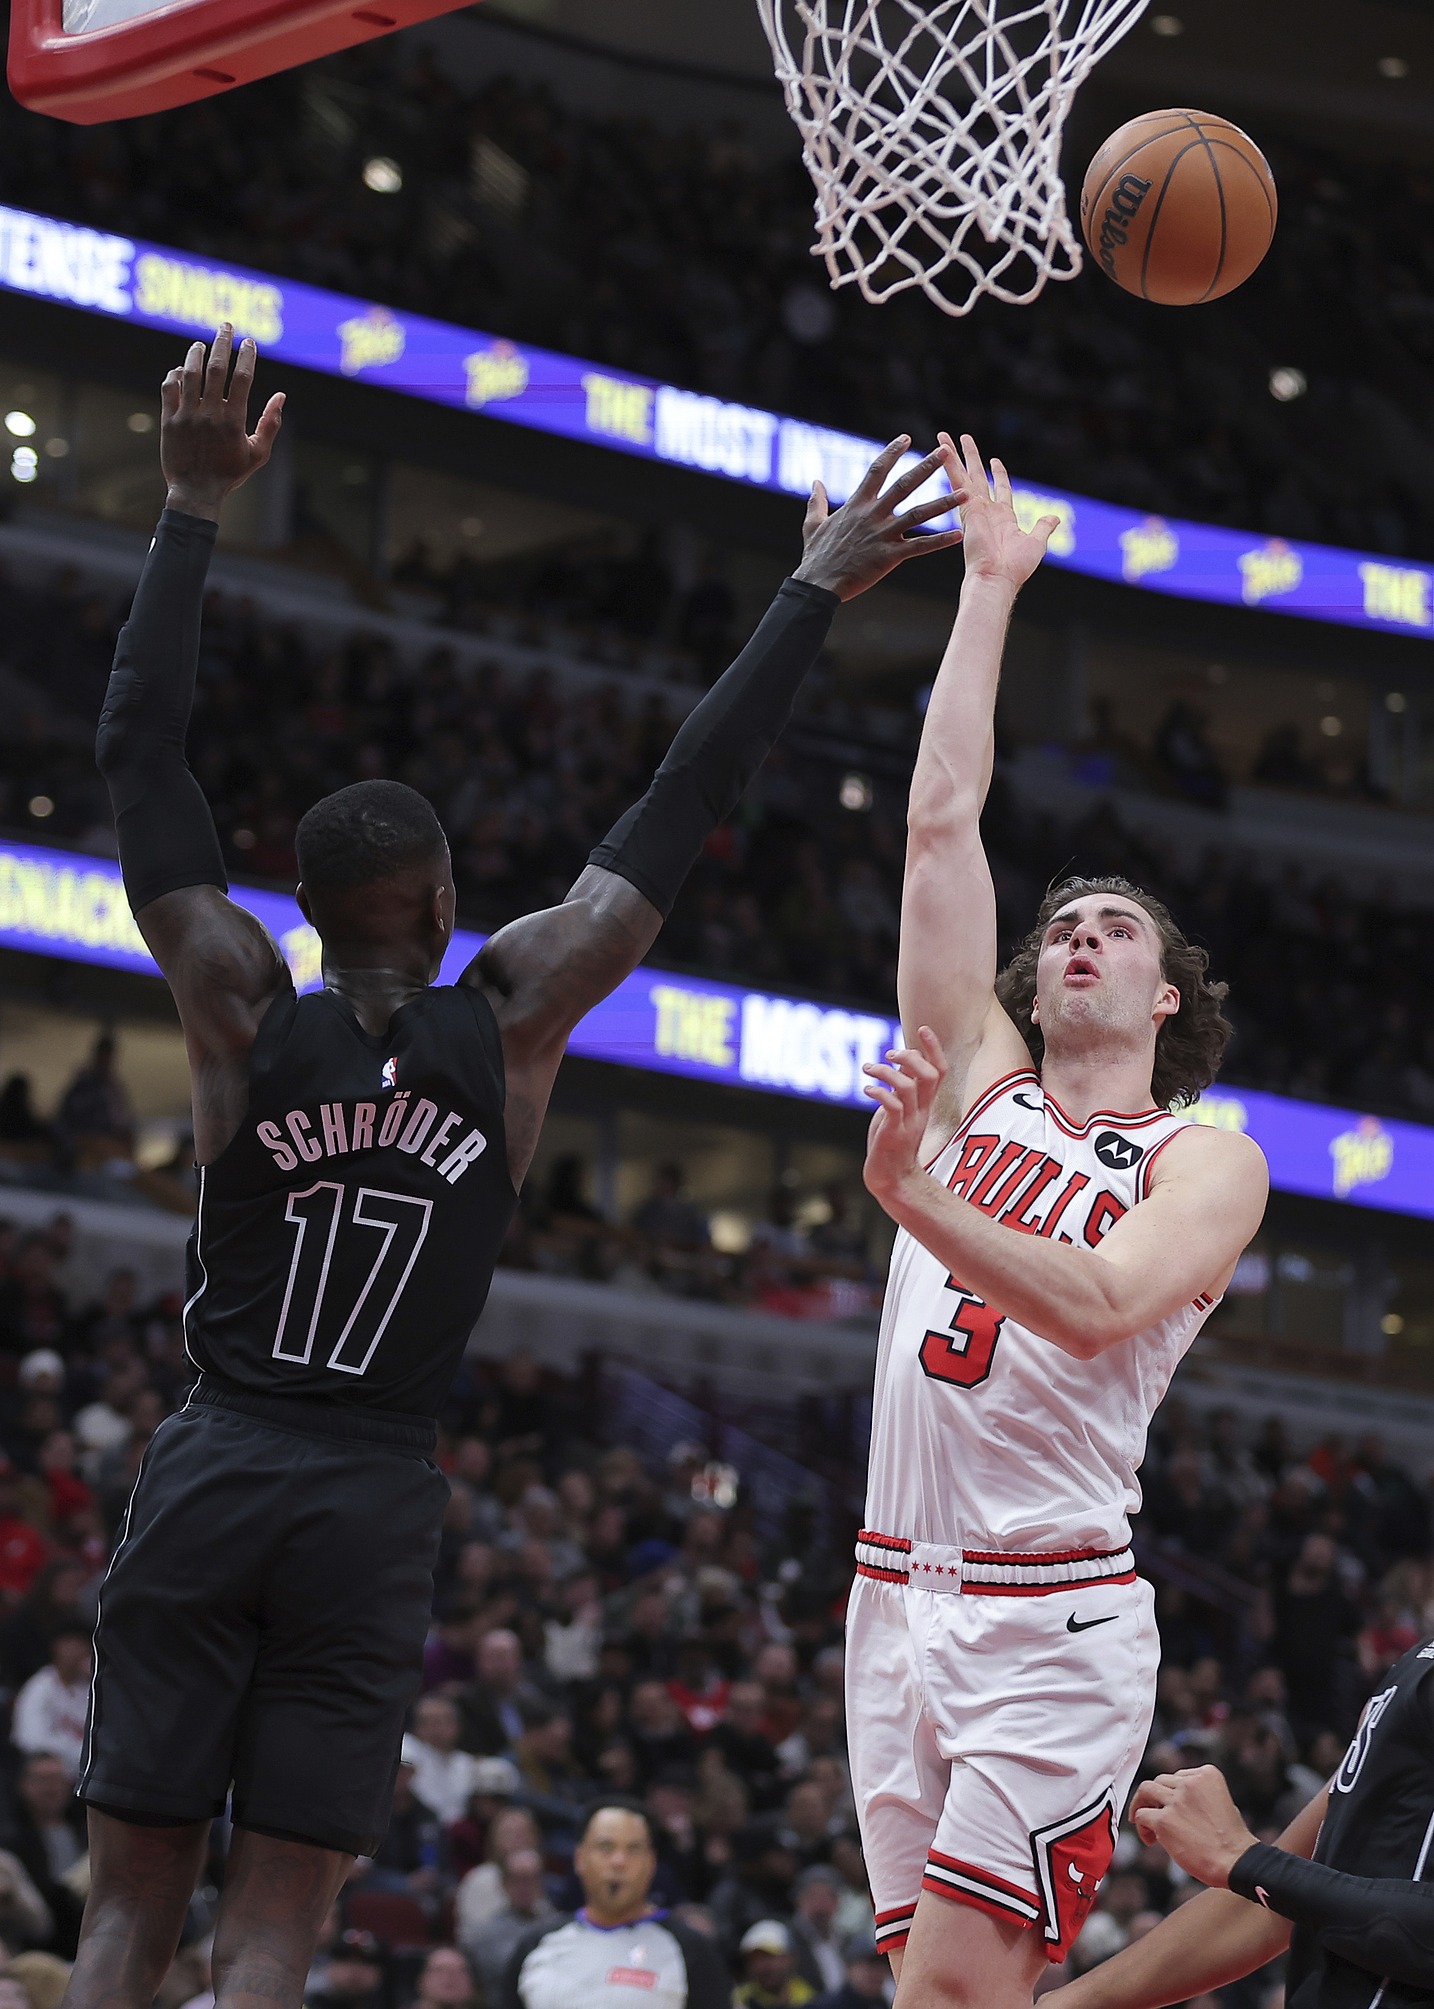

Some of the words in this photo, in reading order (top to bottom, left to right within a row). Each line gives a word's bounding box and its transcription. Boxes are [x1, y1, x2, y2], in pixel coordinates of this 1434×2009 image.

[582, 371, 653, 446] THE
[654, 384, 777, 484] MOST
[652, 984, 734, 1068] THE
[740, 993, 889, 1103] MOST
[256, 1090, 487, 1185] SCHRÖDER
[272, 1180, 434, 1376] 17
[918, 1270, 1006, 1390] 3
